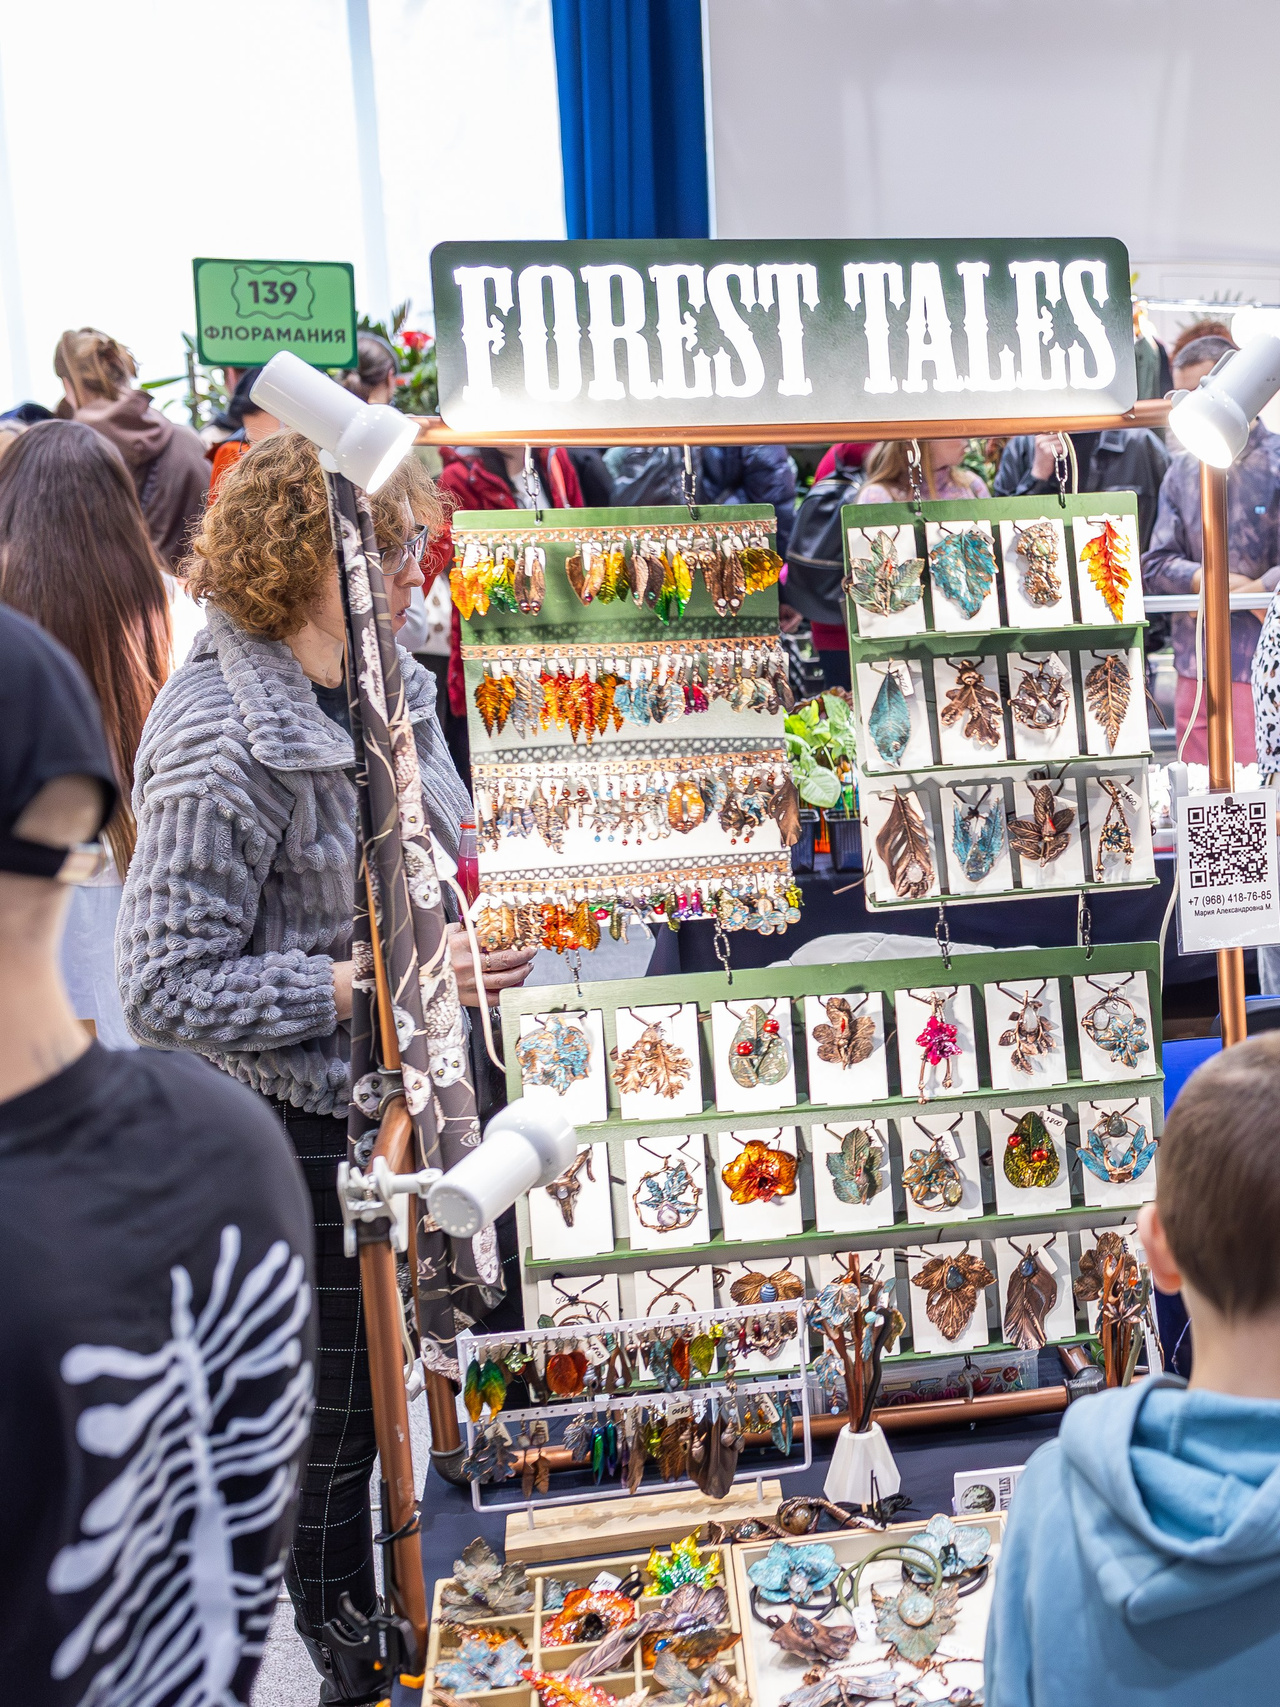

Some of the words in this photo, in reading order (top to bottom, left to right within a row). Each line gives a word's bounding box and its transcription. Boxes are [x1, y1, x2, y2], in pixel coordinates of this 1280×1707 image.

[248, 280, 298, 304] 139
[204, 325, 346, 344] ФЛОРАМАНИЯ
[453, 263, 821, 401] FOREST
[843, 260, 1117, 394] TALES
[1188, 896, 1199, 906] +7
[1202, 894, 1225, 907] (968)
[1227, 890, 1272, 904] 418-76-85
[1194, 909, 1215, 917] Мария
[1216, 905, 1264, 915] Александровна
